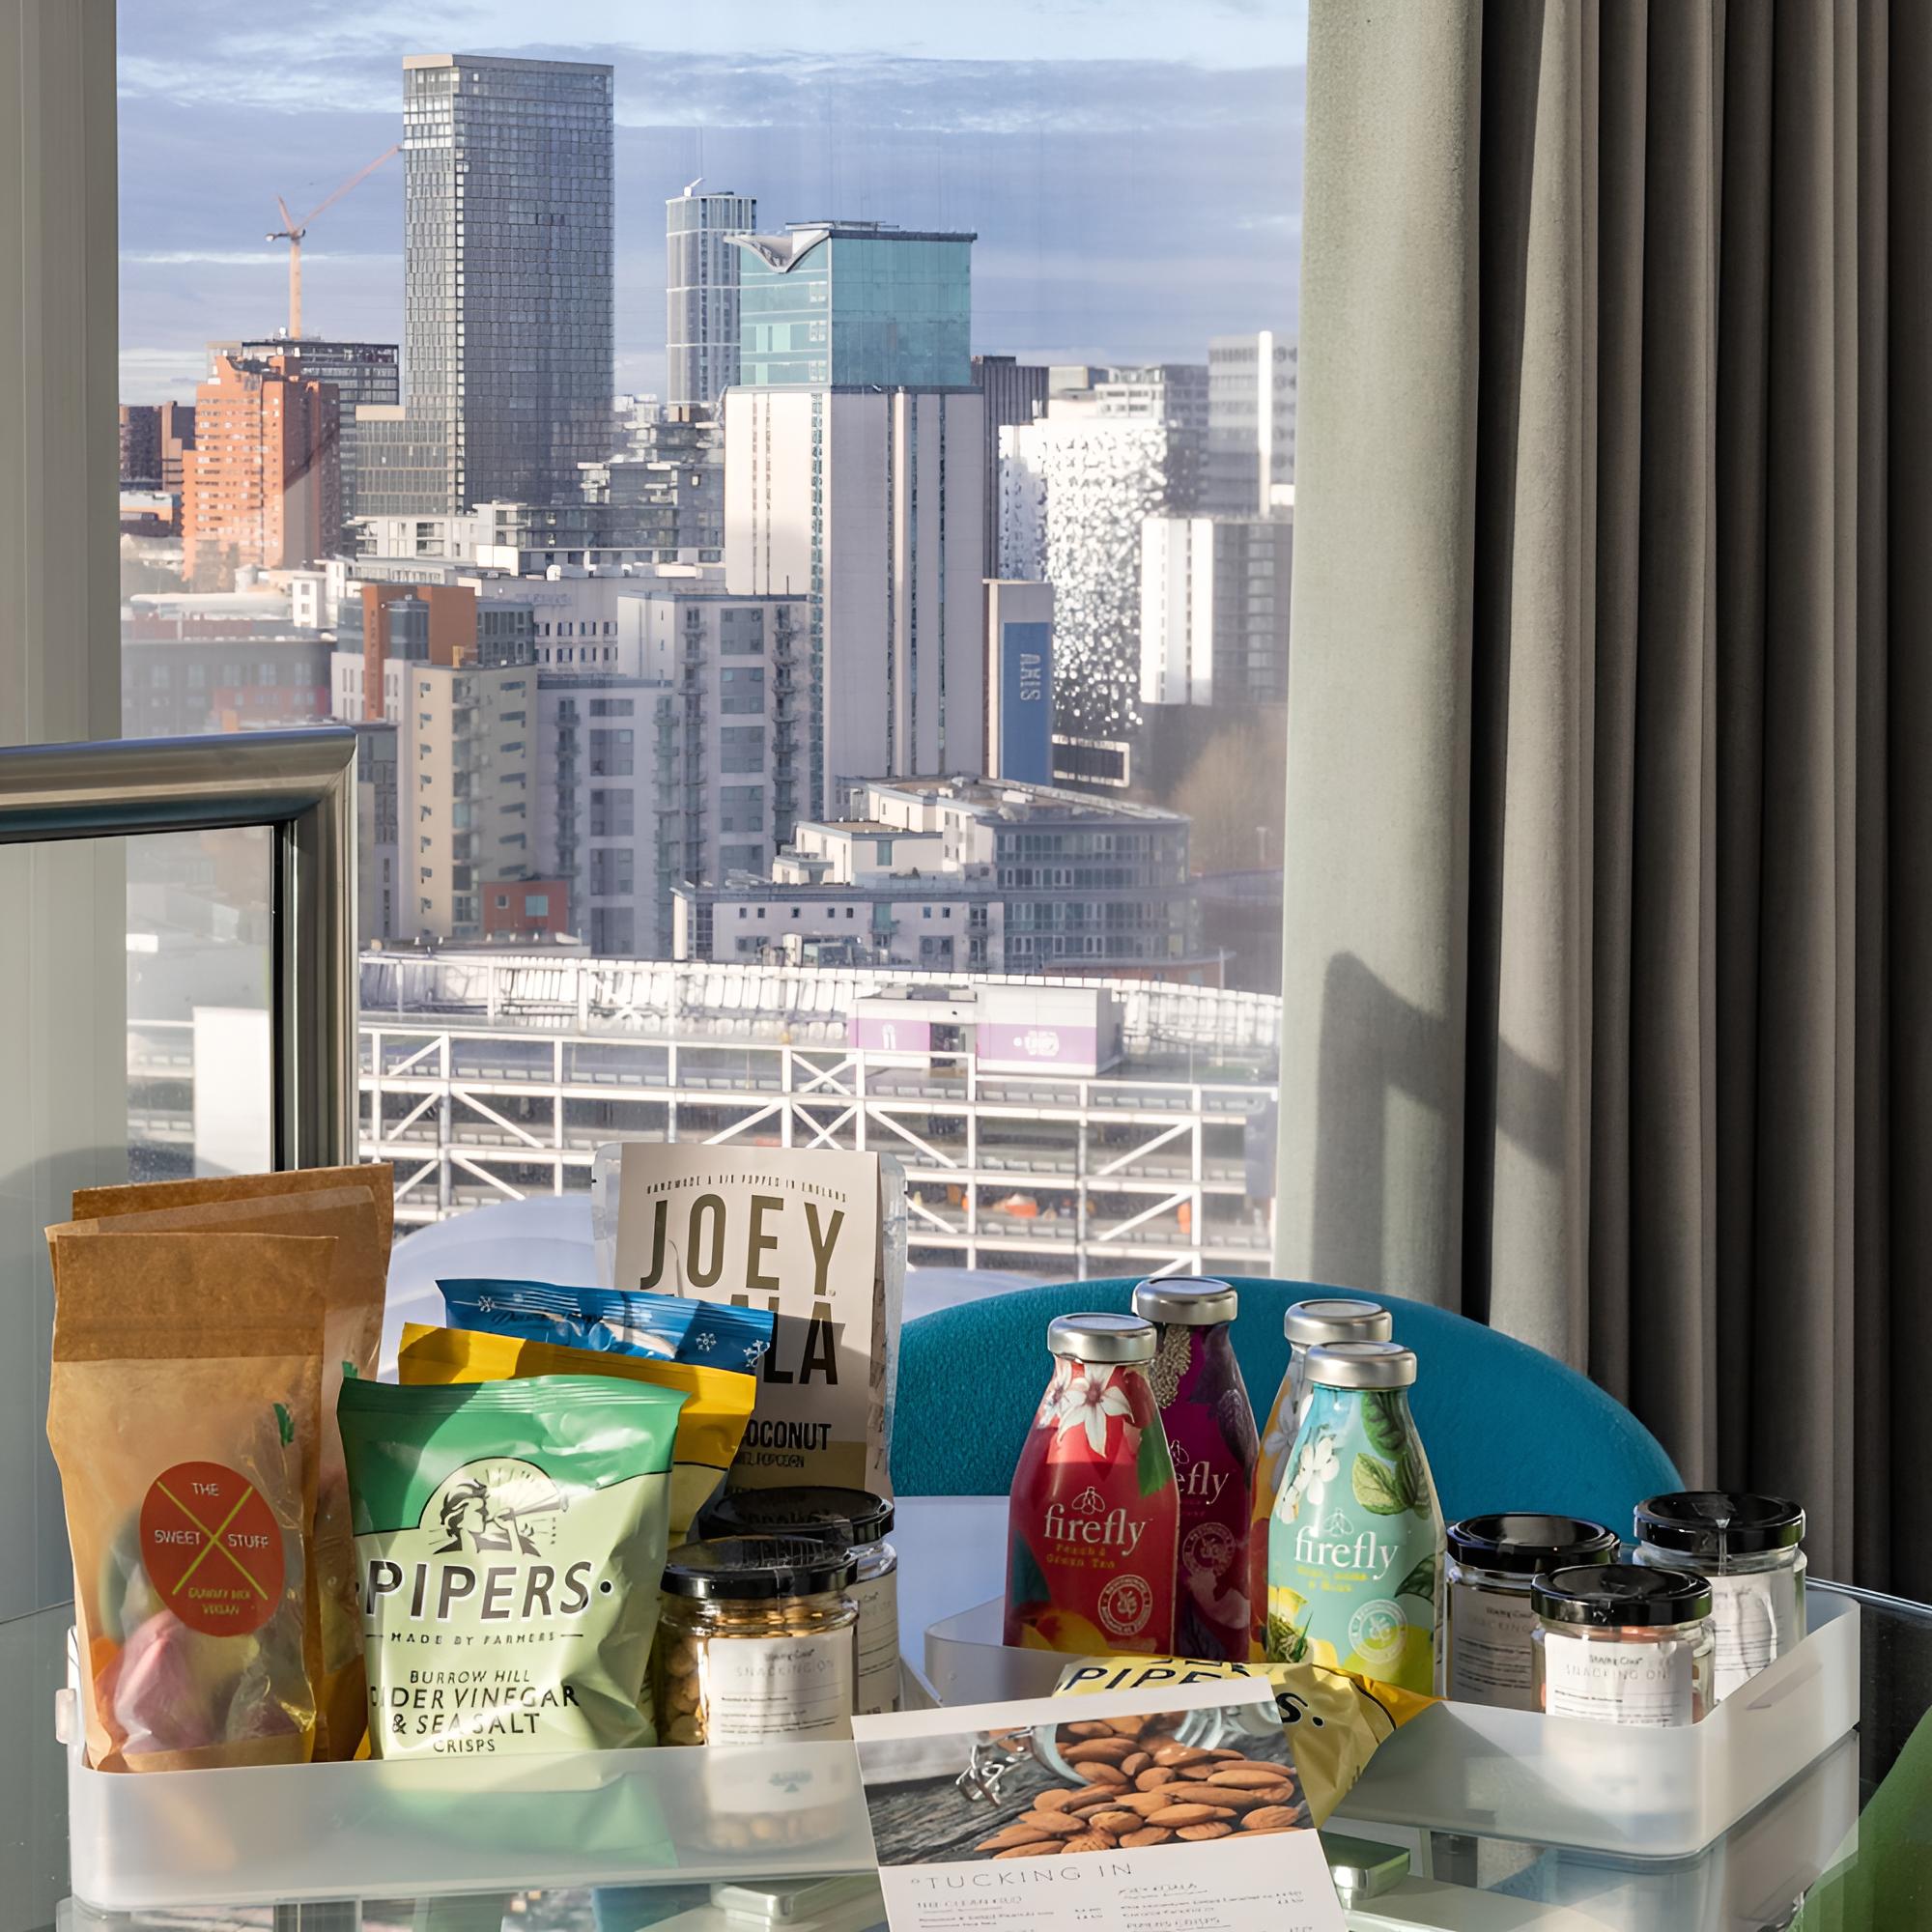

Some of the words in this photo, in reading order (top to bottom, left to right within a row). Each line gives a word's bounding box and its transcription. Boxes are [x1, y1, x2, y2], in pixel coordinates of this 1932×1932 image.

[639, 1193, 845, 1296] JOEY
[740, 1420, 832, 1451] OCONUT
[191, 1482, 221, 1497] THE
[1177, 1461, 1229, 1505] efly
[155, 1529, 200, 1546] SWEET
[227, 1533, 270, 1549] STUFF
[1044, 1503, 1147, 1556] firefly
[1293, 1525, 1399, 1580] firefly
[366, 1559, 593, 1620] PIPERS
[391, 1632, 442, 1645] MADE
[454, 1634, 473, 1646] BY
[483, 1631, 555, 1645] FARMERS
[410, 1669, 487, 1685] BURROW
[494, 1669, 530, 1683] HILL
[454, 1685, 580, 1709] VINEGAR
[392, 1713, 407, 1735] &
[416, 1714, 462, 1736] SEA
[472, 1713, 540, 1735] SALT
[433, 1738, 496, 1753] CRISPS
[925, 1866, 1081, 1889] TUCKING
[1098, 1862, 1131, 1878] IN
